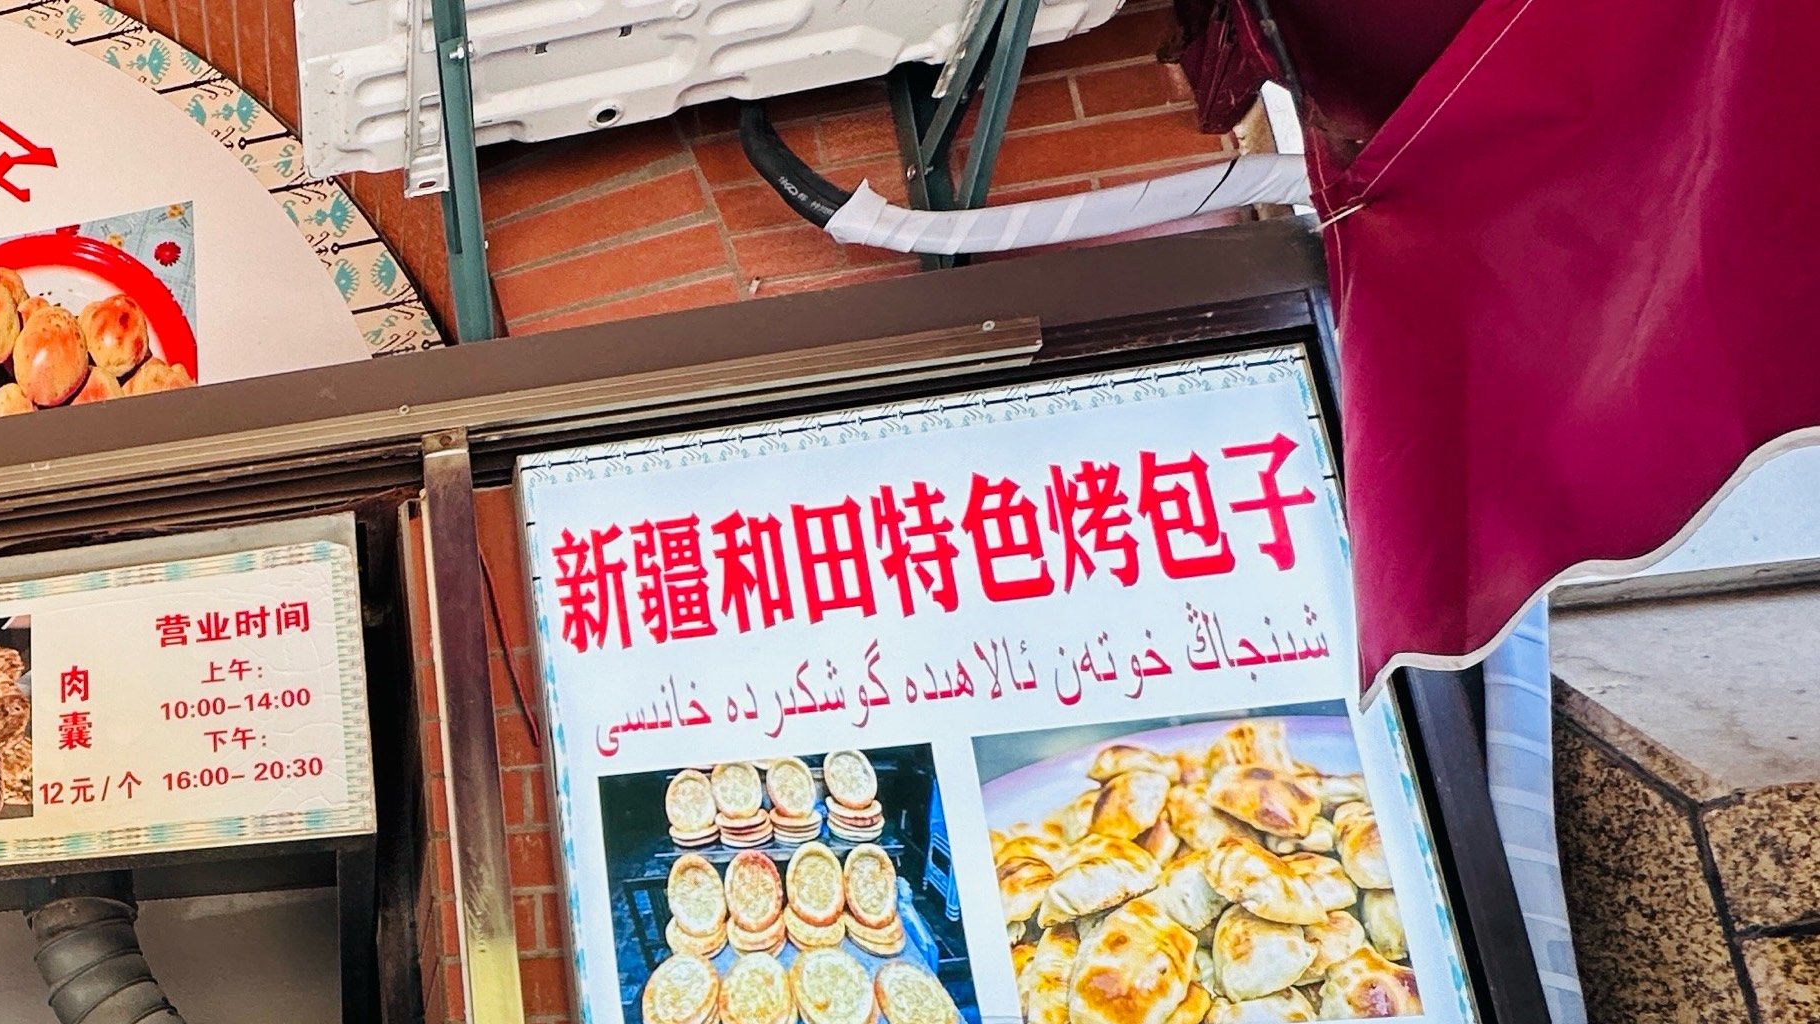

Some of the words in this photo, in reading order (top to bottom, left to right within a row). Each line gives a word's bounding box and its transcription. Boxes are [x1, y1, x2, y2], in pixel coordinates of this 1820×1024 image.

[551, 432, 1317, 654] 新疆和田特色烤包子
[155, 600, 312, 649] 营业时间
[57, 664, 94, 751] 肉囊
